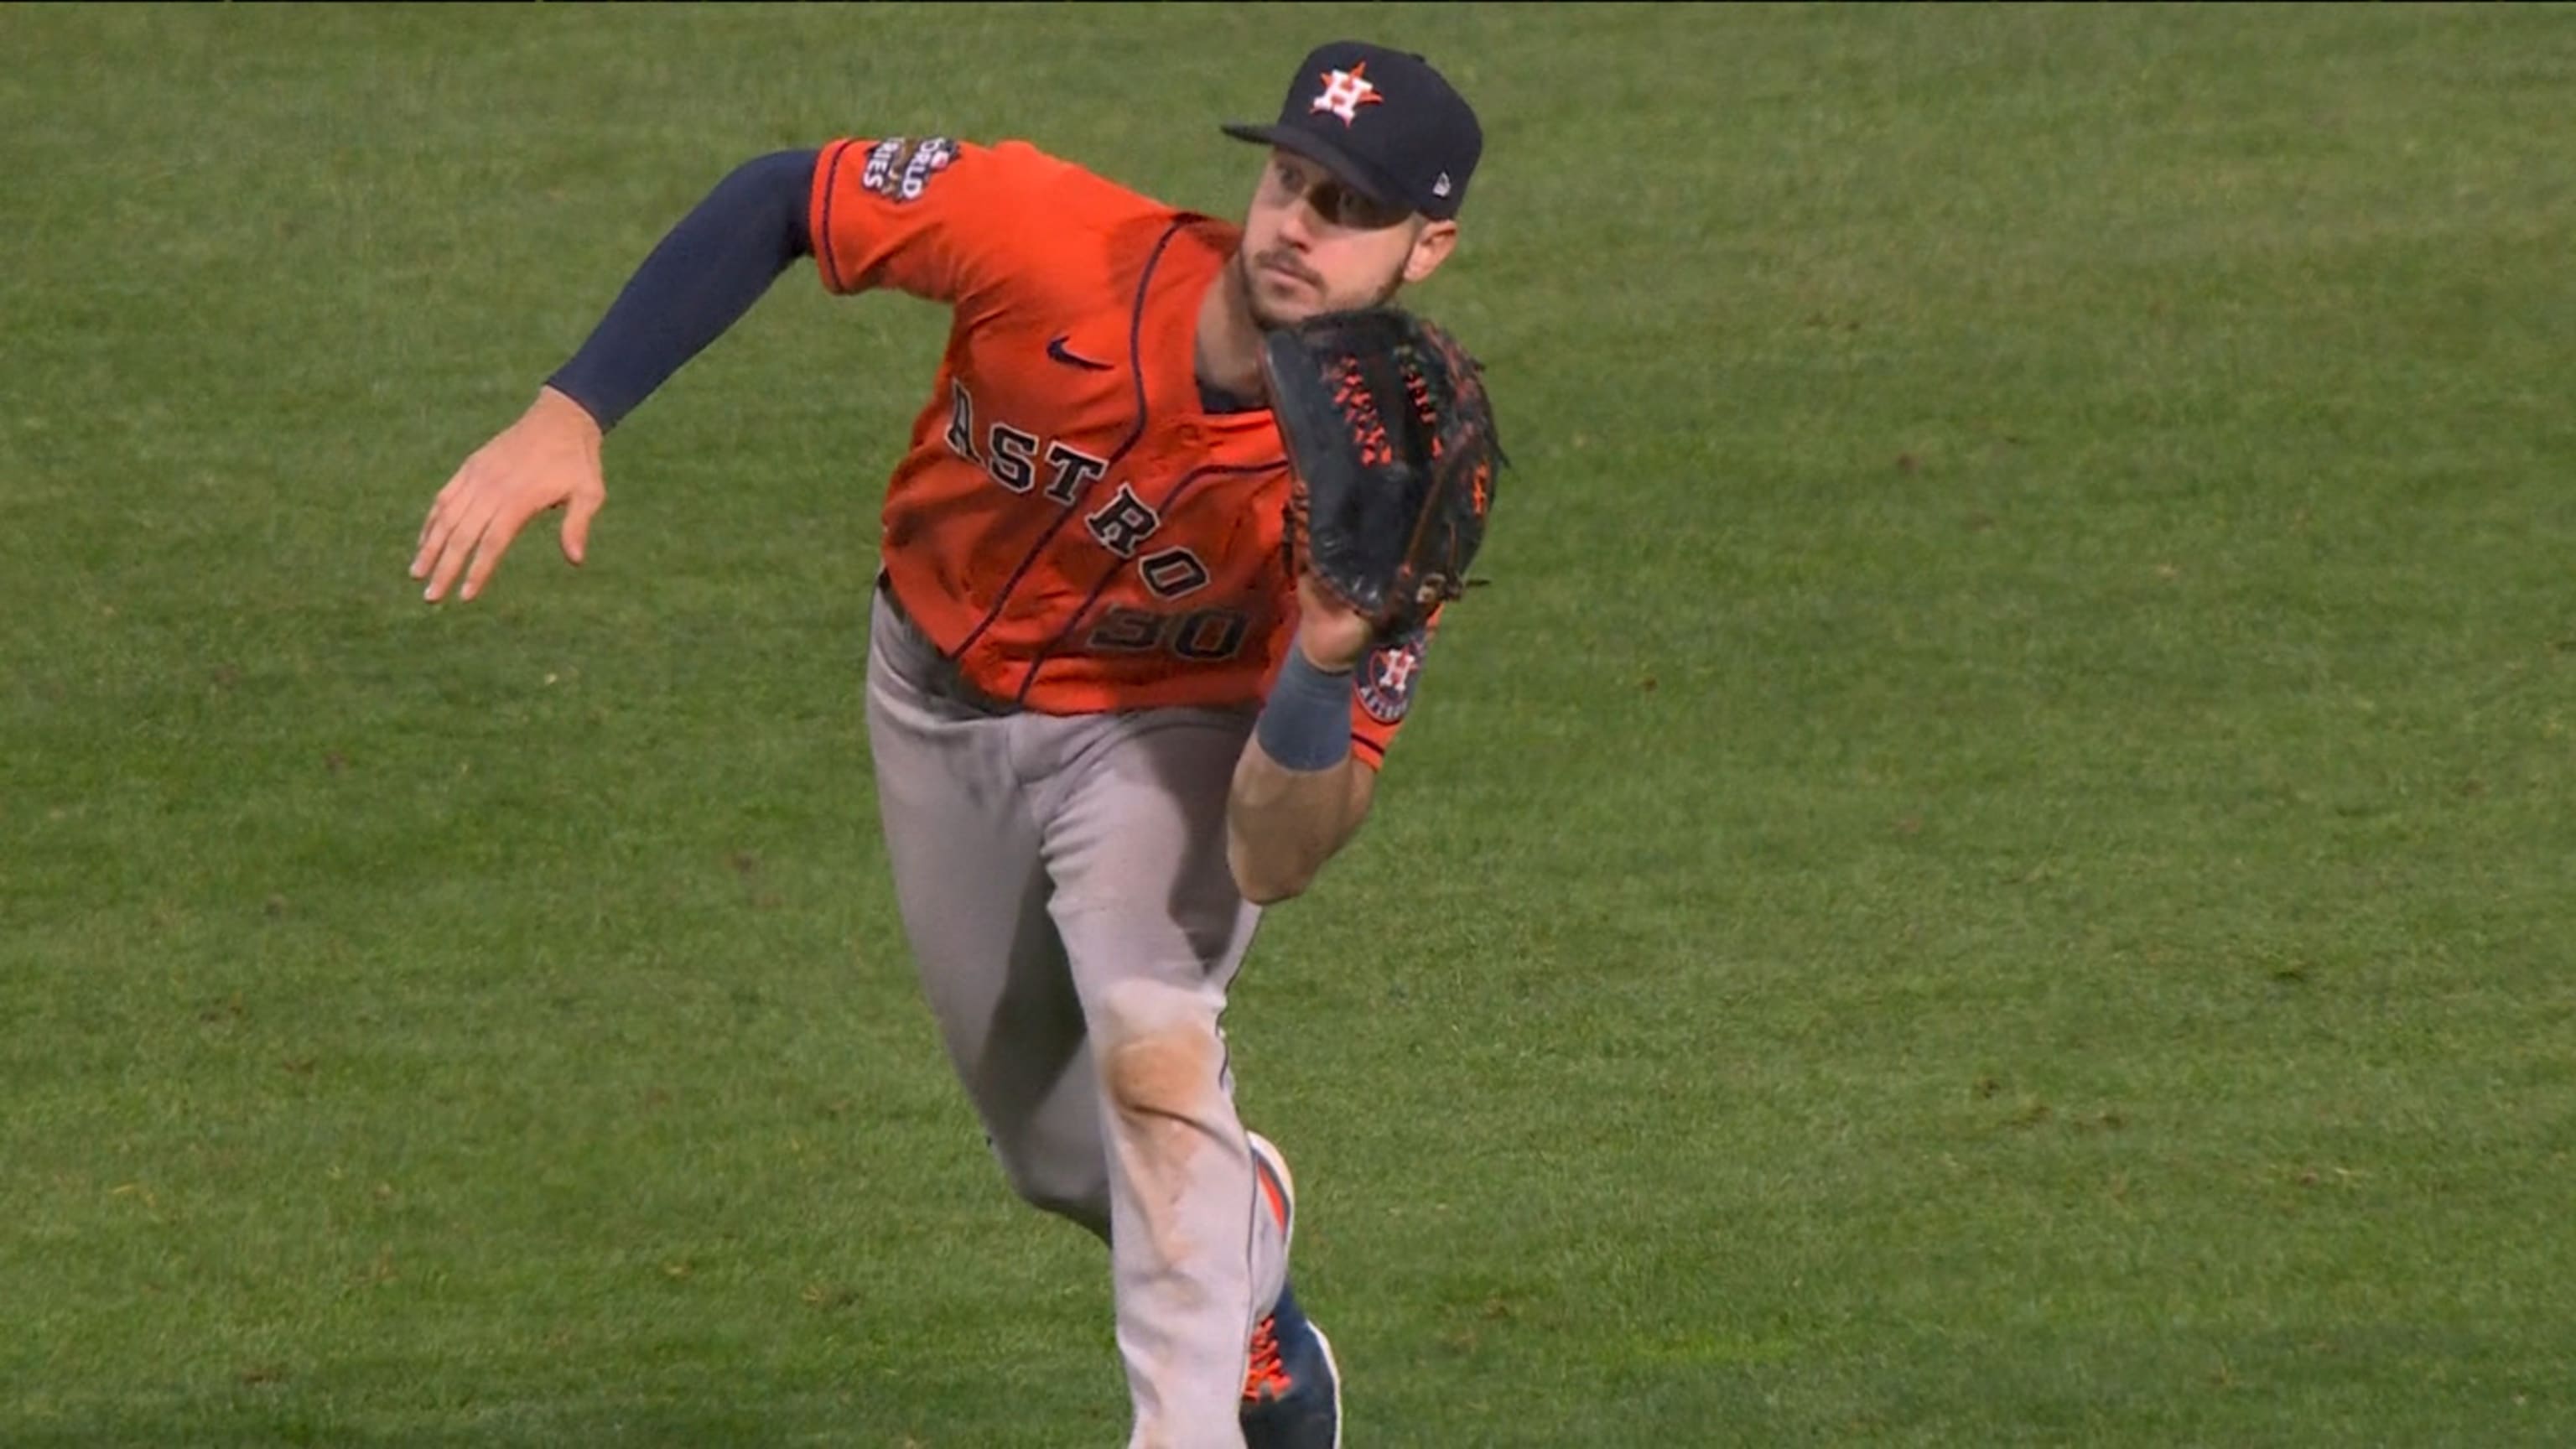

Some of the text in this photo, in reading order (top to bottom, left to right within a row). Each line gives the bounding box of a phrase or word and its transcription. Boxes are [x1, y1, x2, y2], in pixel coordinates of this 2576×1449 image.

[1313, 69, 1374, 119] H
[862, 137, 906, 188] RIES
[902, 138, 946, 200] ORLD
[945, 377, 1210, 601] ASTRO
[1379, 648, 1415, 691] H
